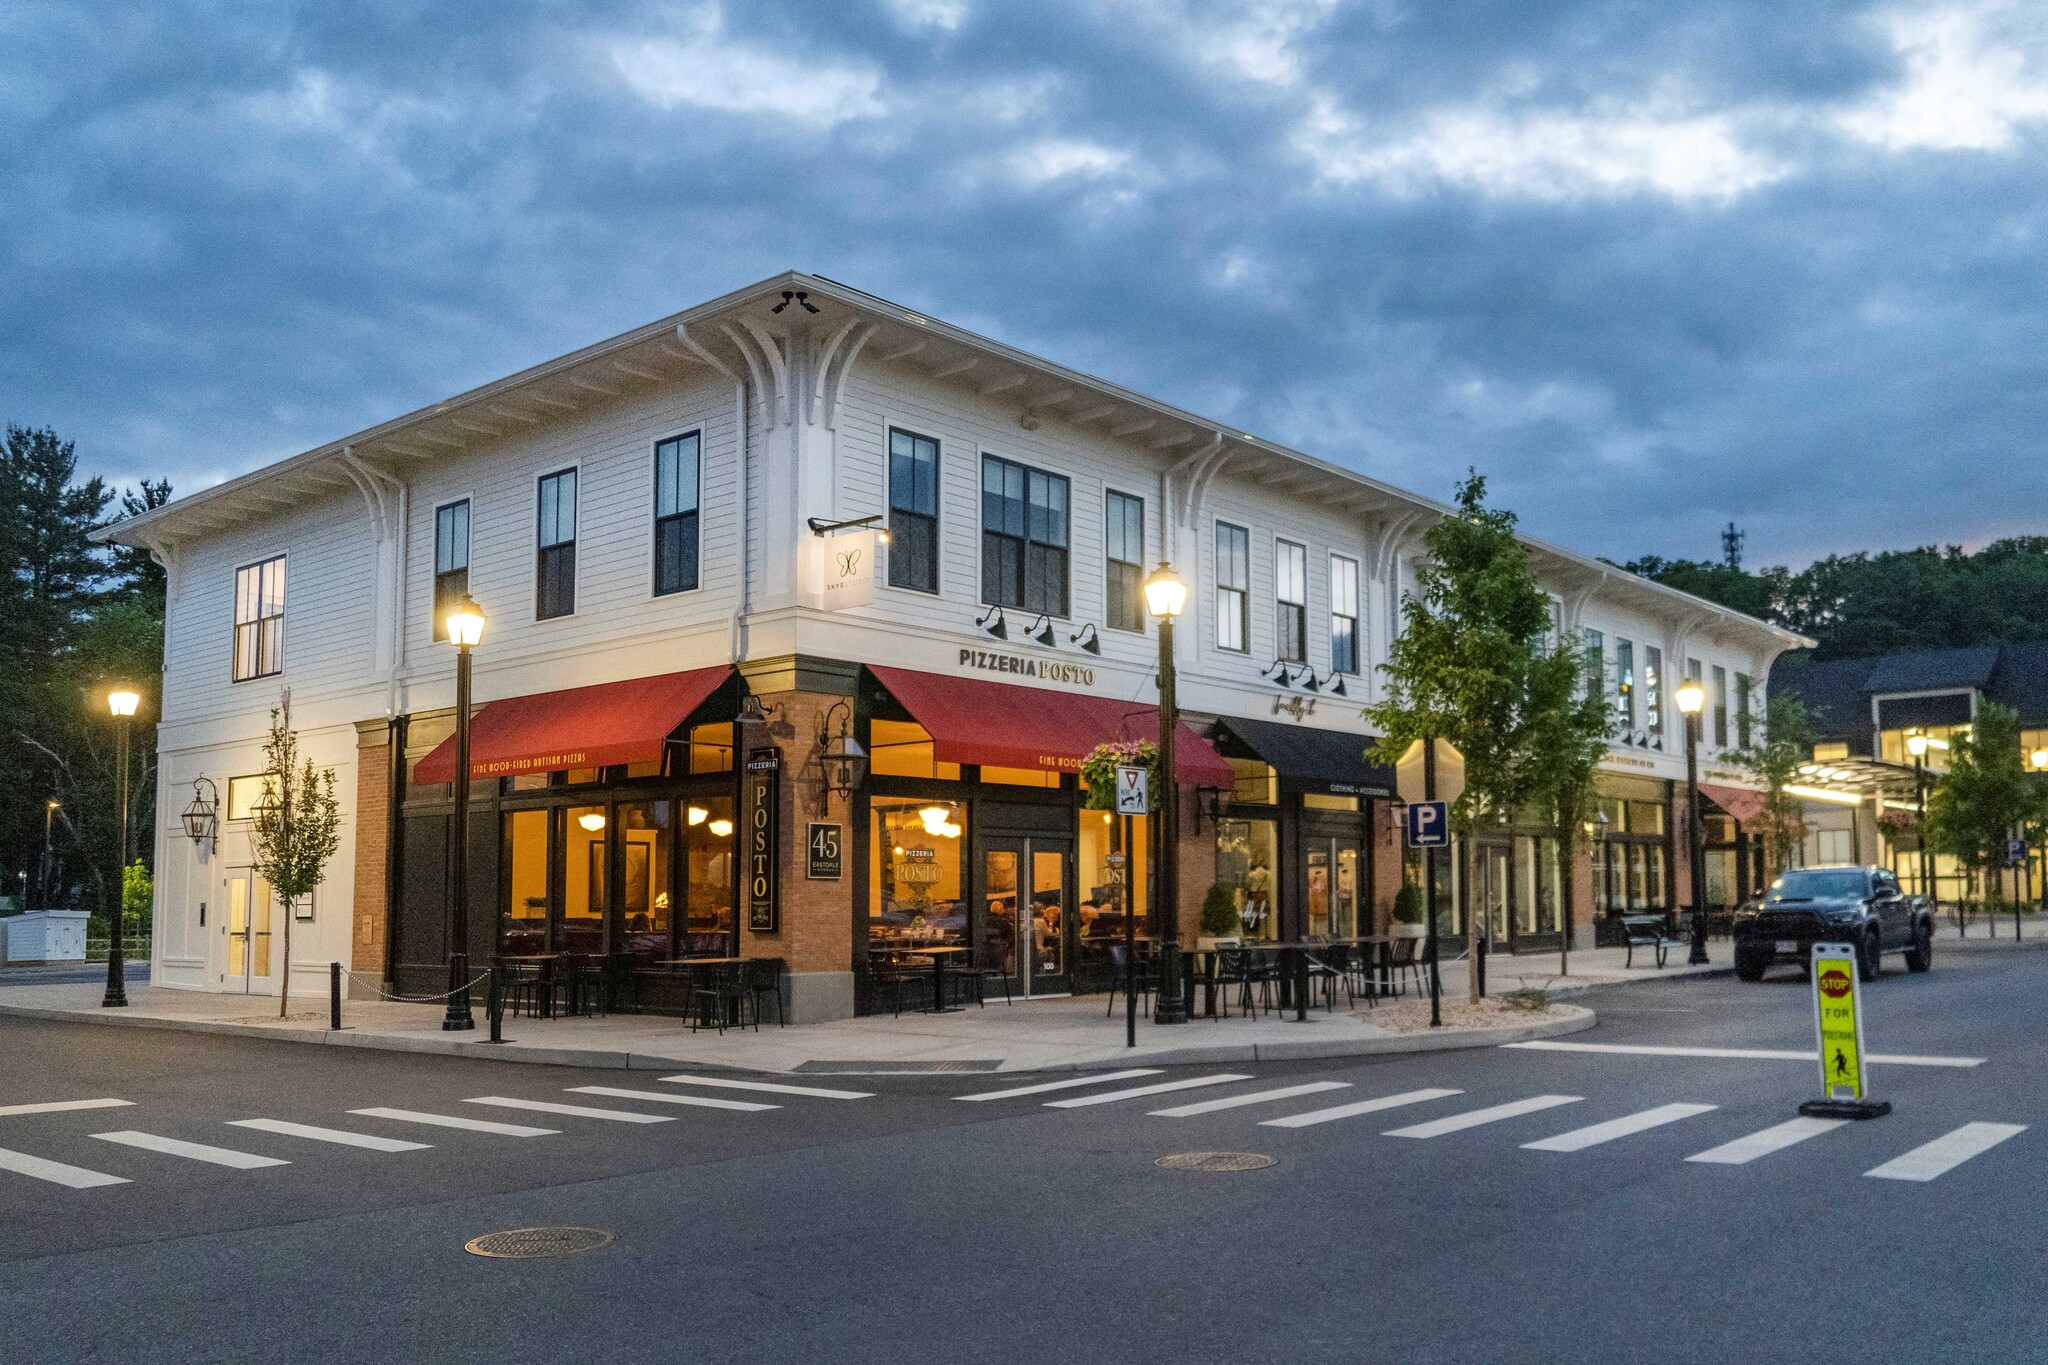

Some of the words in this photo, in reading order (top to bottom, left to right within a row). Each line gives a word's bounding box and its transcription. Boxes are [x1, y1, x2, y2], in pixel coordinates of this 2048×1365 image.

[959, 649, 1036, 677] PIZZERIA
[1039, 661, 1095, 686] POSTO
[473, 764, 487, 774] FINE
[488, 759, 531, 773] WOOD-FIRED
[533, 755, 561, 768] ARTISAN
[563, 753, 586, 764] PIZZAS
[747, 760, 777, 771] PIZZERIA
[1039, 755, 1056, 767] FINE
[1417, 806, 1437, 834] P
[754, 786, 768, 897] POSTO
[812, 829, 838, 859] 45
[895, 864, 943, 882] POSTO
[1821, 979, 1848, 990] STOP
[1825, 1008, 1849, 1018] FOR
